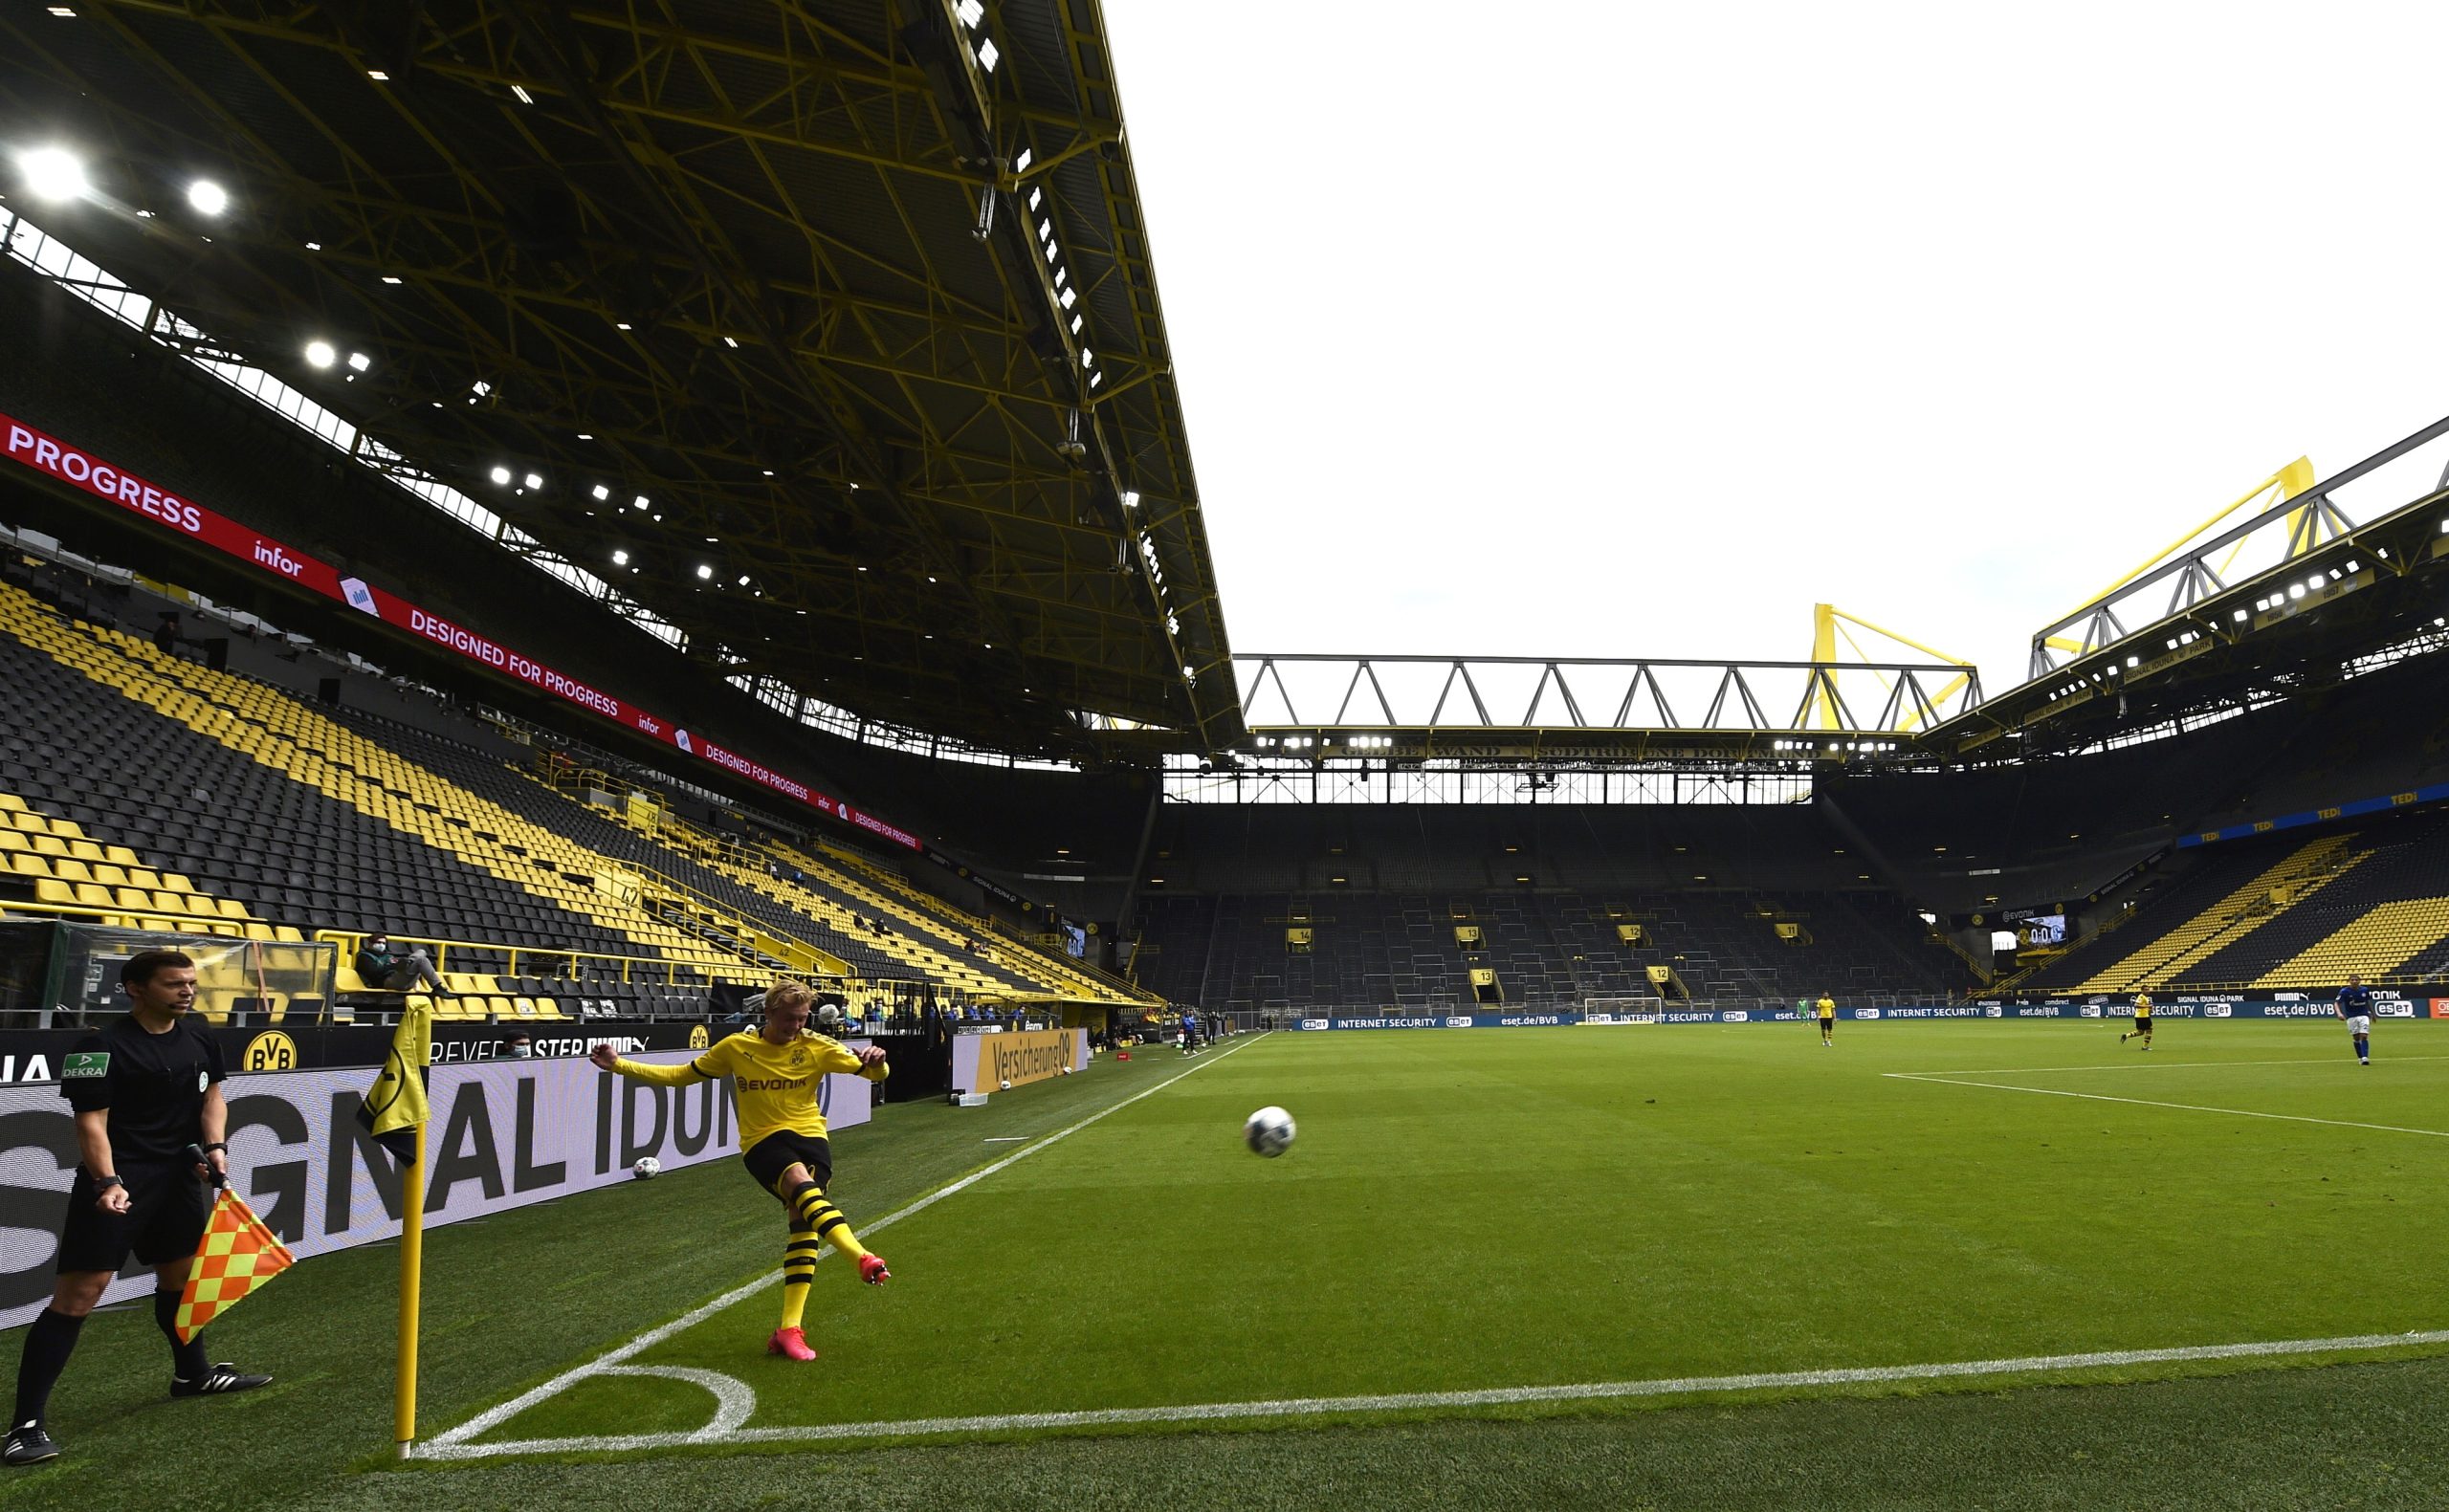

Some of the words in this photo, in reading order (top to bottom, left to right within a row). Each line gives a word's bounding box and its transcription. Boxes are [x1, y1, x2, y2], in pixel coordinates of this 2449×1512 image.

[8, 425, 202, 532] PROGRESS
[254, 539, 302, 577] infor
[411, 609, 504, 666] DESIGNED
[509, 655, 541, 684] FOR
[545, 670, 618, 716] PROGRESS
[2125, 666, 2151, 681] SIGNAL
[2151, 655, 2174, 671] IDUNA
[2190, 641, 2211, 654] PARK
[638, 714, 659, 734] infor
[1433, 746, 1501, 756] WAND
[706, 744, 751, 775] DESIGNED
[752, 766, 769, 783] FOR
[770, 774, 807, 800] PROGRESS
[818, 796, 830, 810] infor
[2391, 792, 2417, 805] TEDi
[2317, 807, 2341, 820] TEDi
[855, 812, 881, 832] DESIGNED
[882, 824, 893, 837] FOR
[892, 829, 916, 847] PROGRESS
[2254, 820, 2274, 832] TEDi
[1300, 931, 1310, 940] 14
[1467, 929, 1477, 937] 13
[1630, 927, 1639, 936] 12
[2031, 927, 2048, 943] 0:0
[1481, 972, 1491, 981] 13
[1657, 970, 1666, 978] 12
[2369, 991, 2400, 999] ONIK
[1887, 1009, 1932, 1018] INTERNET
[1934, 1008, 1980, 1017] SECURITY
[2107, 1006, 2136, 1016] INTERN
[2151, 1005, 2195, 1016] SECURITY
[1338, 1019, 1387, 1029] INTERNET
[1389, 1018, 1436, 1028] SECURITY
[1621, 1014, 1666, 1022] INTERNET
[1668, 1013, 1714, 1021] SECURITY
[693, 1029, 706, 1048] BVB
[253, 1038, 291, 1070] BVB
[430, 1040, 504, 1063] REVE
[526, 1039, 584, 1058] STER
[63, 1067, 103, 1078] DEKRA
[748, 1078, 808, 1090] EVONIK
[0, 1078, 565, 1310] SGNAL
[595, 1071, 739, 1175] IDUN
